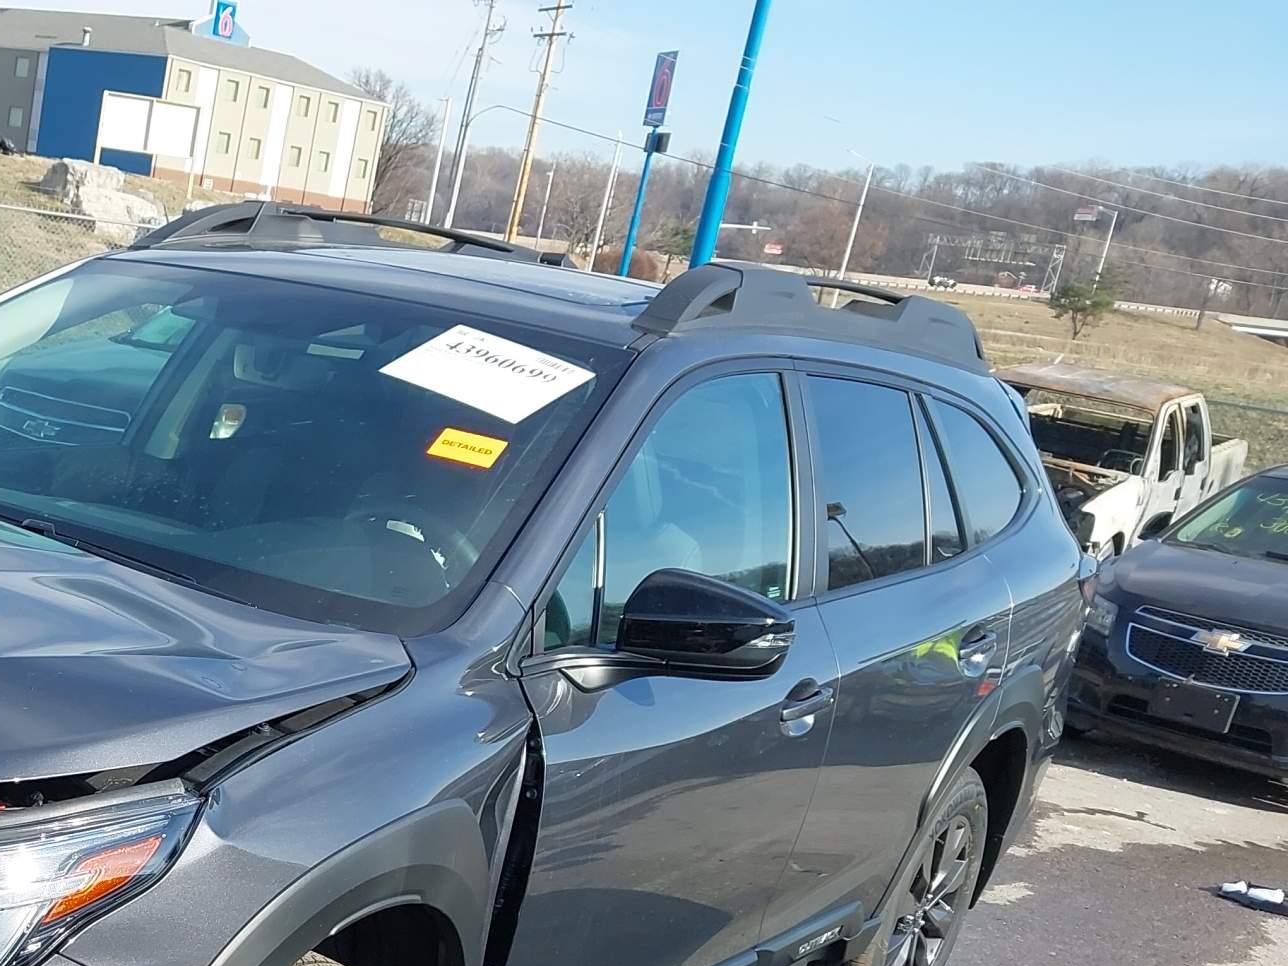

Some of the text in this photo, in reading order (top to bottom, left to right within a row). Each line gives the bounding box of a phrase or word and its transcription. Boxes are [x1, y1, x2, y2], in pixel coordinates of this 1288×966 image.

[219, 6, 233, 37] 6
[446, 341, 557, 383] 43960699
[441, 439, 493, 455] DETAILED
